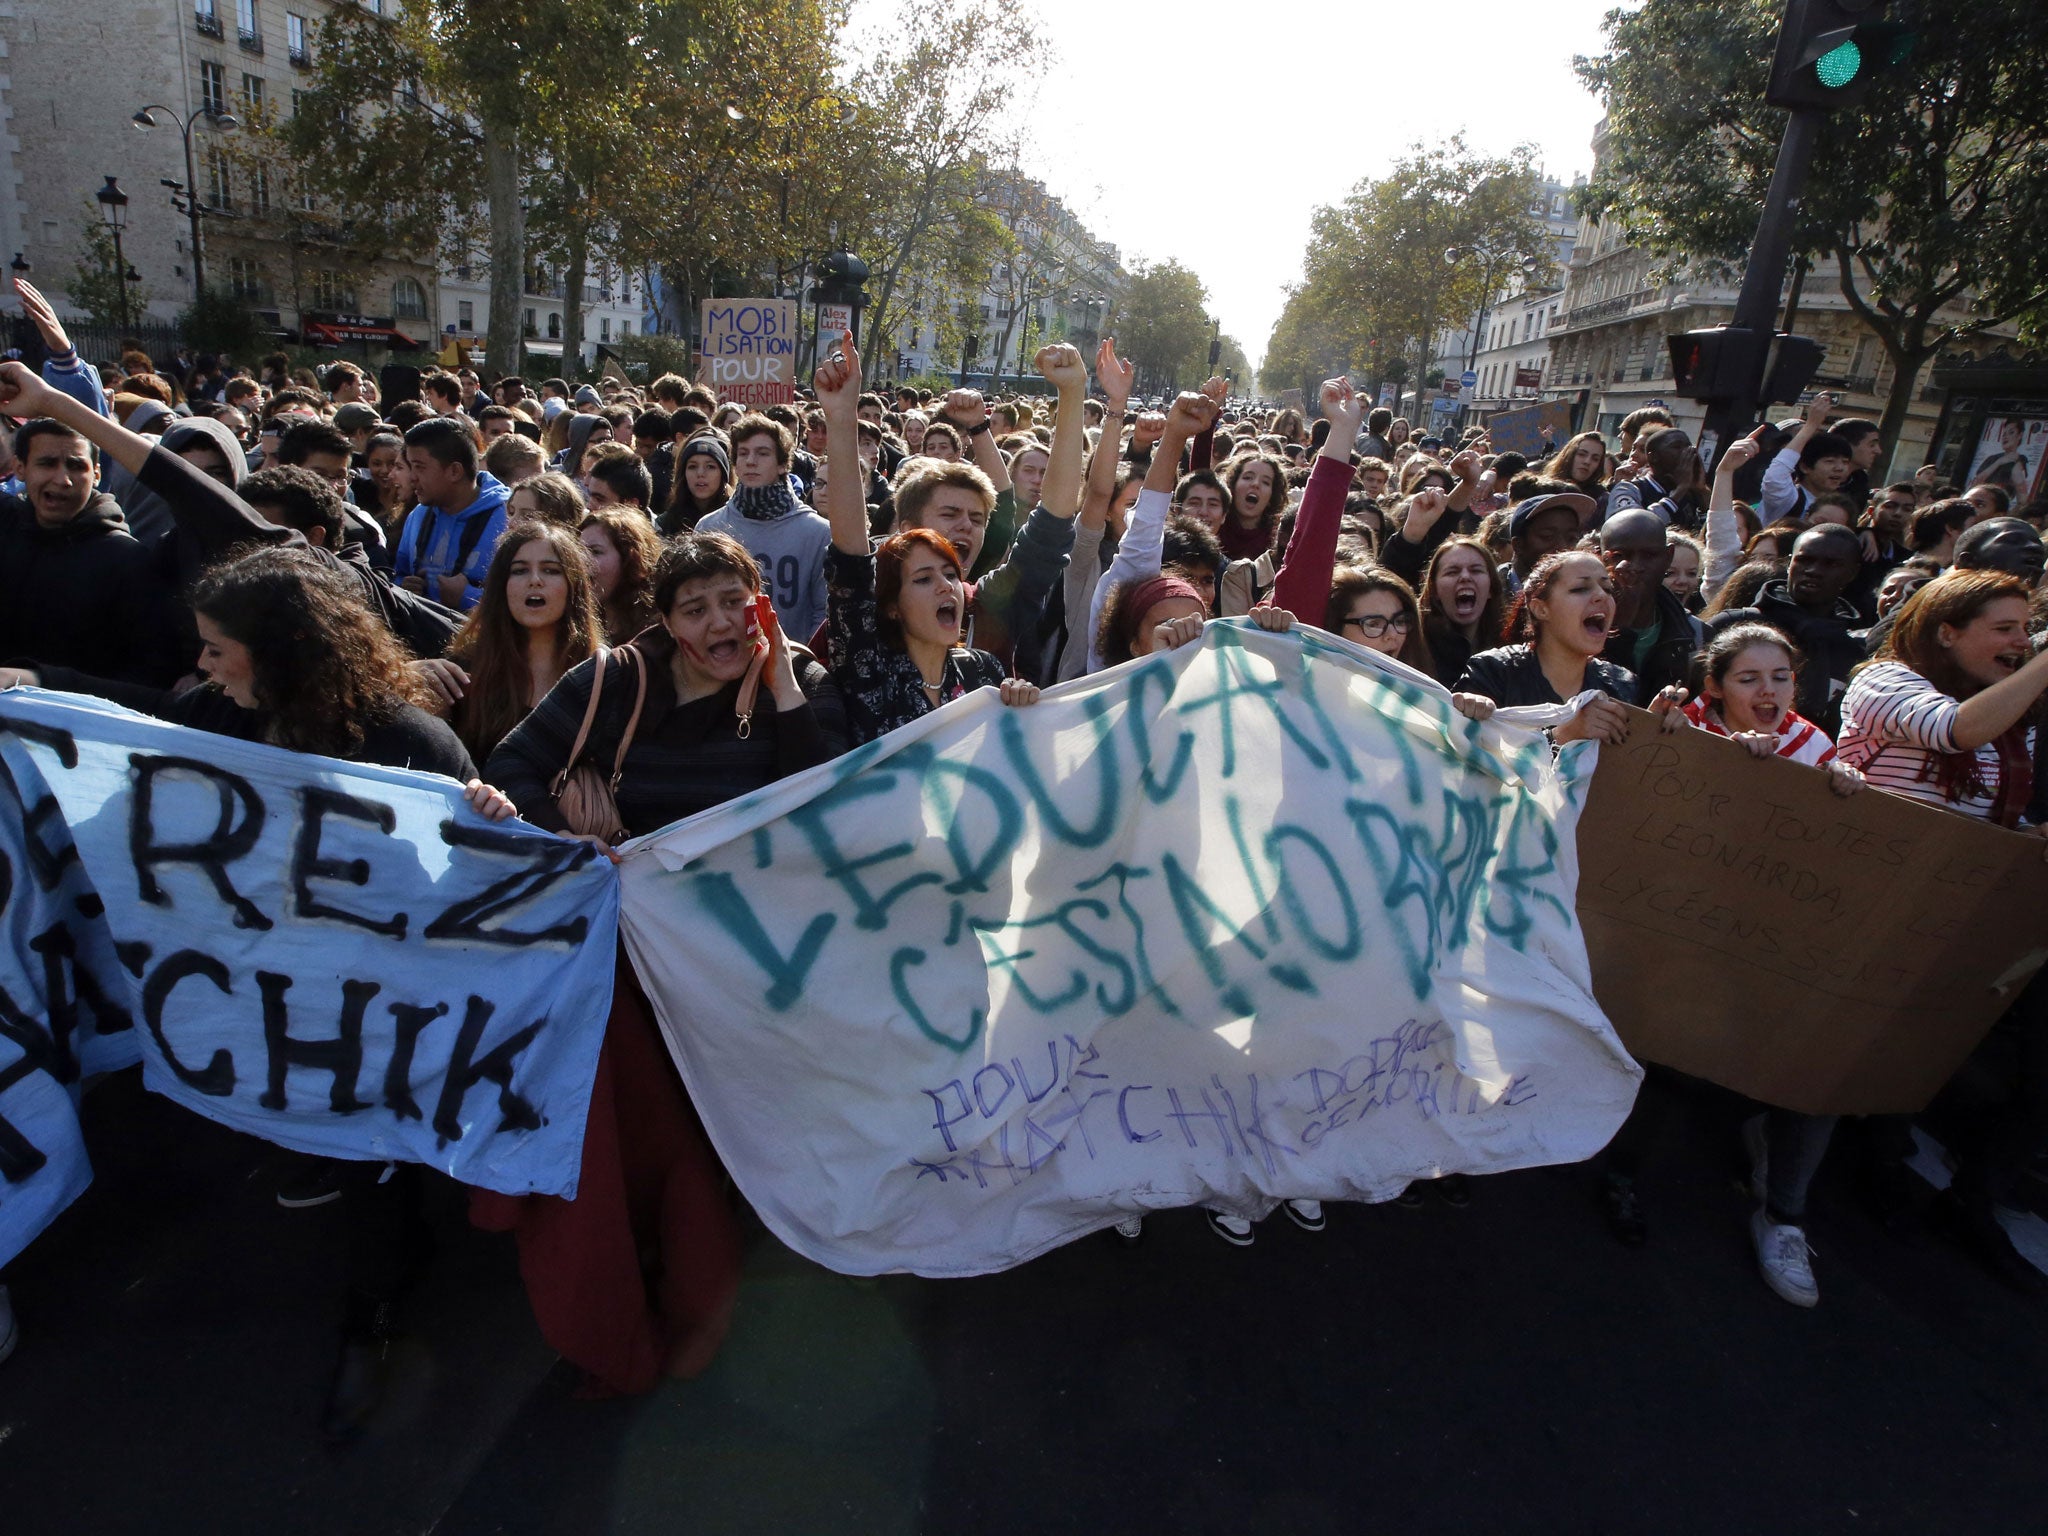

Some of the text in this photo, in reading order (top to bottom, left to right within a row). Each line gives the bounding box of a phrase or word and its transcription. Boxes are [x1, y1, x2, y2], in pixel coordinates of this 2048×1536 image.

[707, 304, 787, 336] MOBI
[820, 319, 848, 330] Lutz
[821, 307, 848, 319] Alex
[702, 332, 793, 357] LISATION
[713, 357, 782, 382] POUR
[1628, 742, 2019, 894] POUR TOUTES LES
[920, 1034, 1109, 1153] POUR
